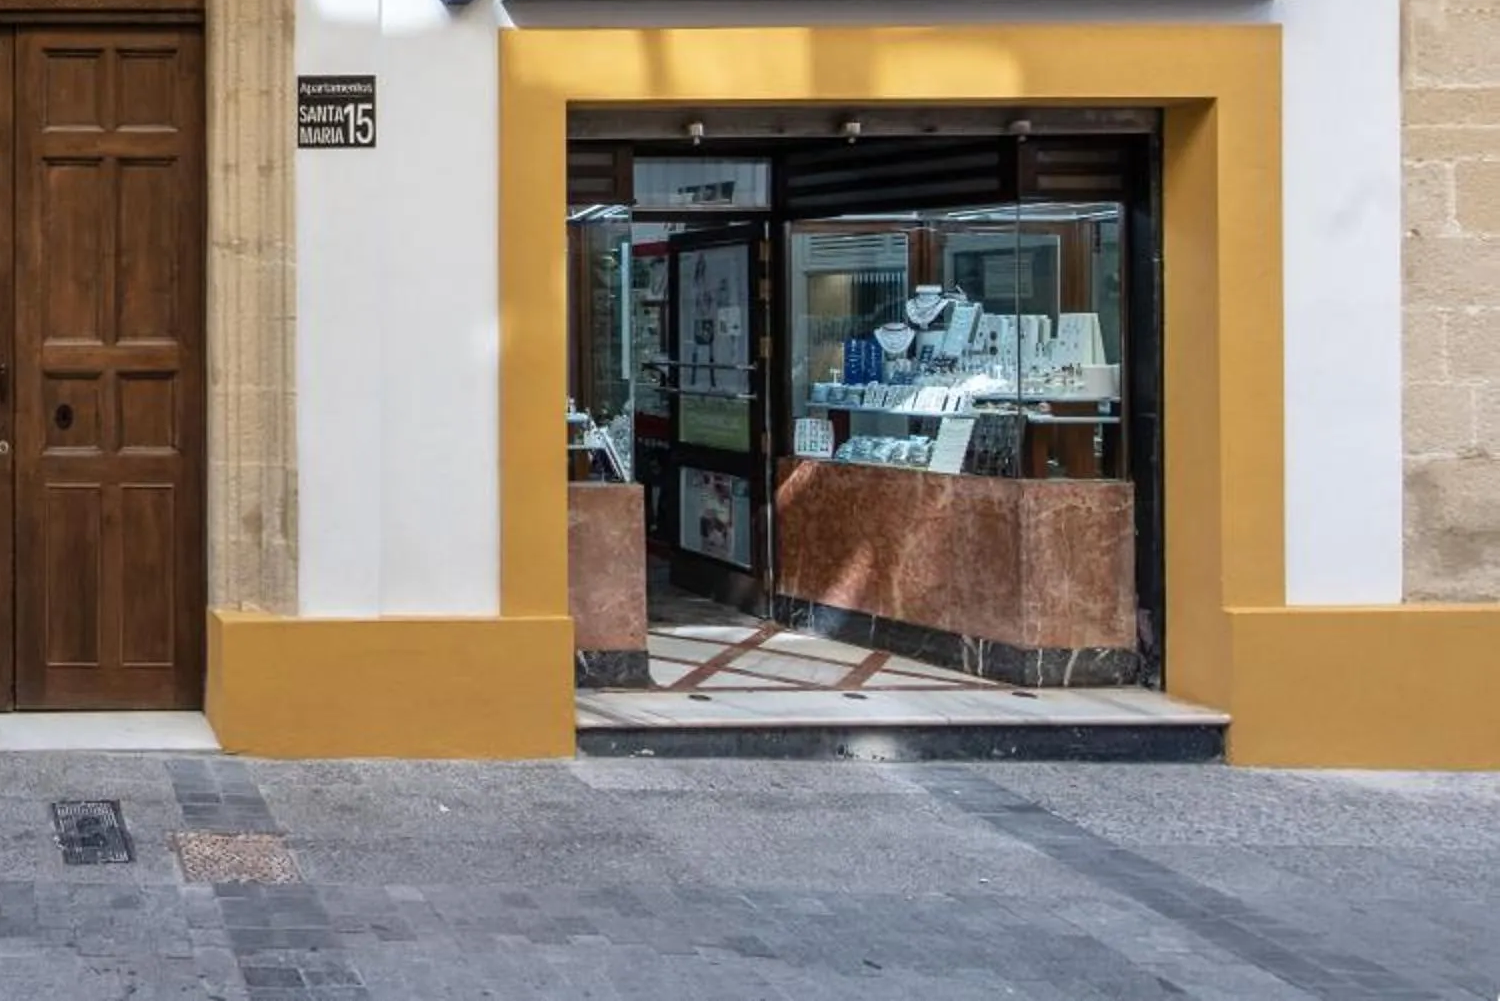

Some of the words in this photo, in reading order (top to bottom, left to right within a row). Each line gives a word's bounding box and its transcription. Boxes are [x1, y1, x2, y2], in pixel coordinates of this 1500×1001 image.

[300, 105, 344, 123] SANTA
[344, 103, 373, 144] 15
[300, 126, 345, 144] MARIA
